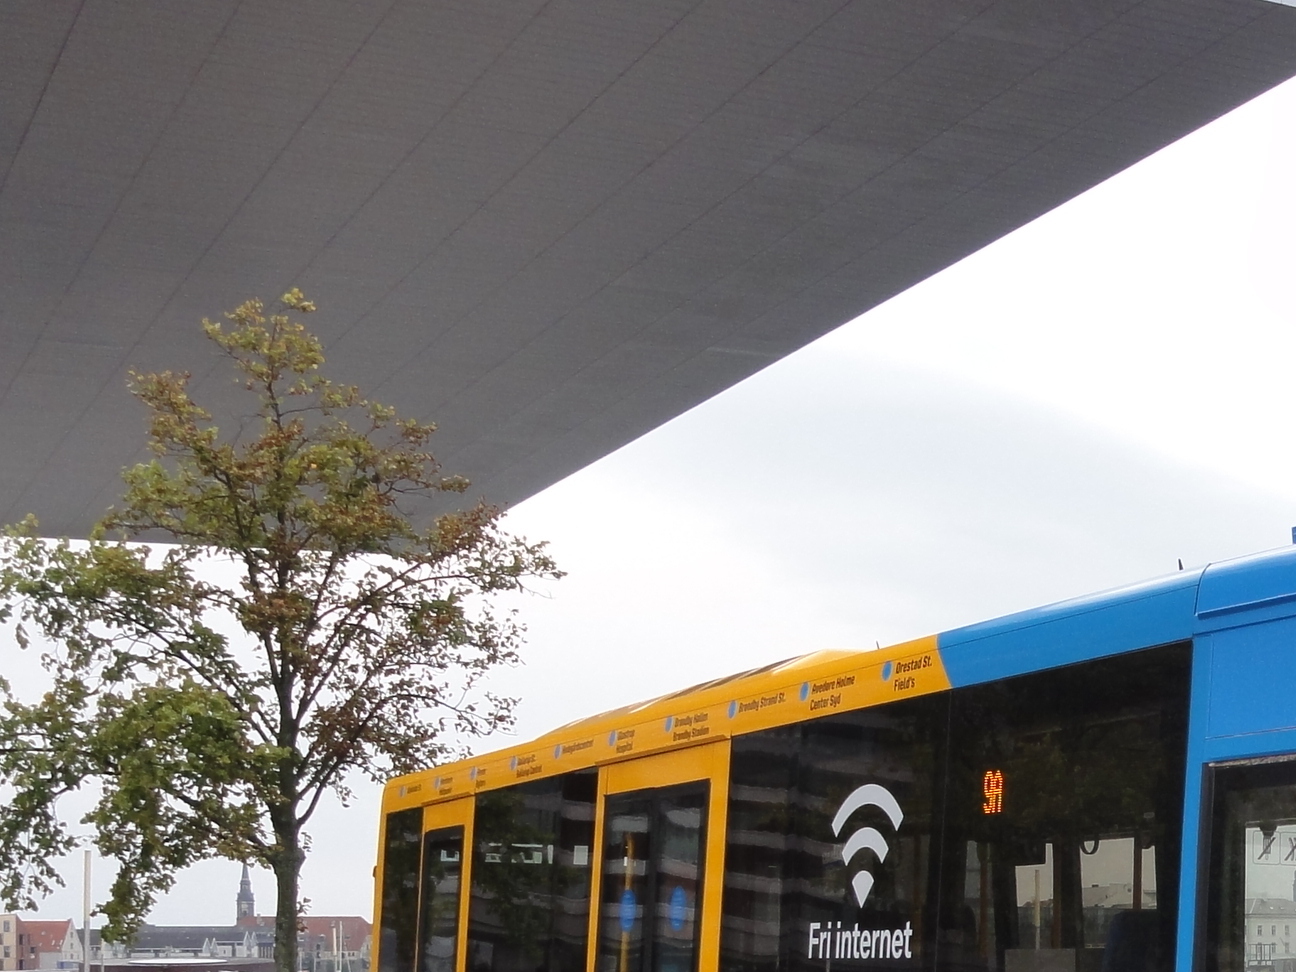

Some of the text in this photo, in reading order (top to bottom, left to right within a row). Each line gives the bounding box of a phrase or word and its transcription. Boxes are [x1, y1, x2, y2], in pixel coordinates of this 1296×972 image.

[922, 655, 932, 668] St.
[893, 678, 915, 691] Field's
[809, 697, 829, 711] Center
[808, 920, 913, 959] Fri internet
